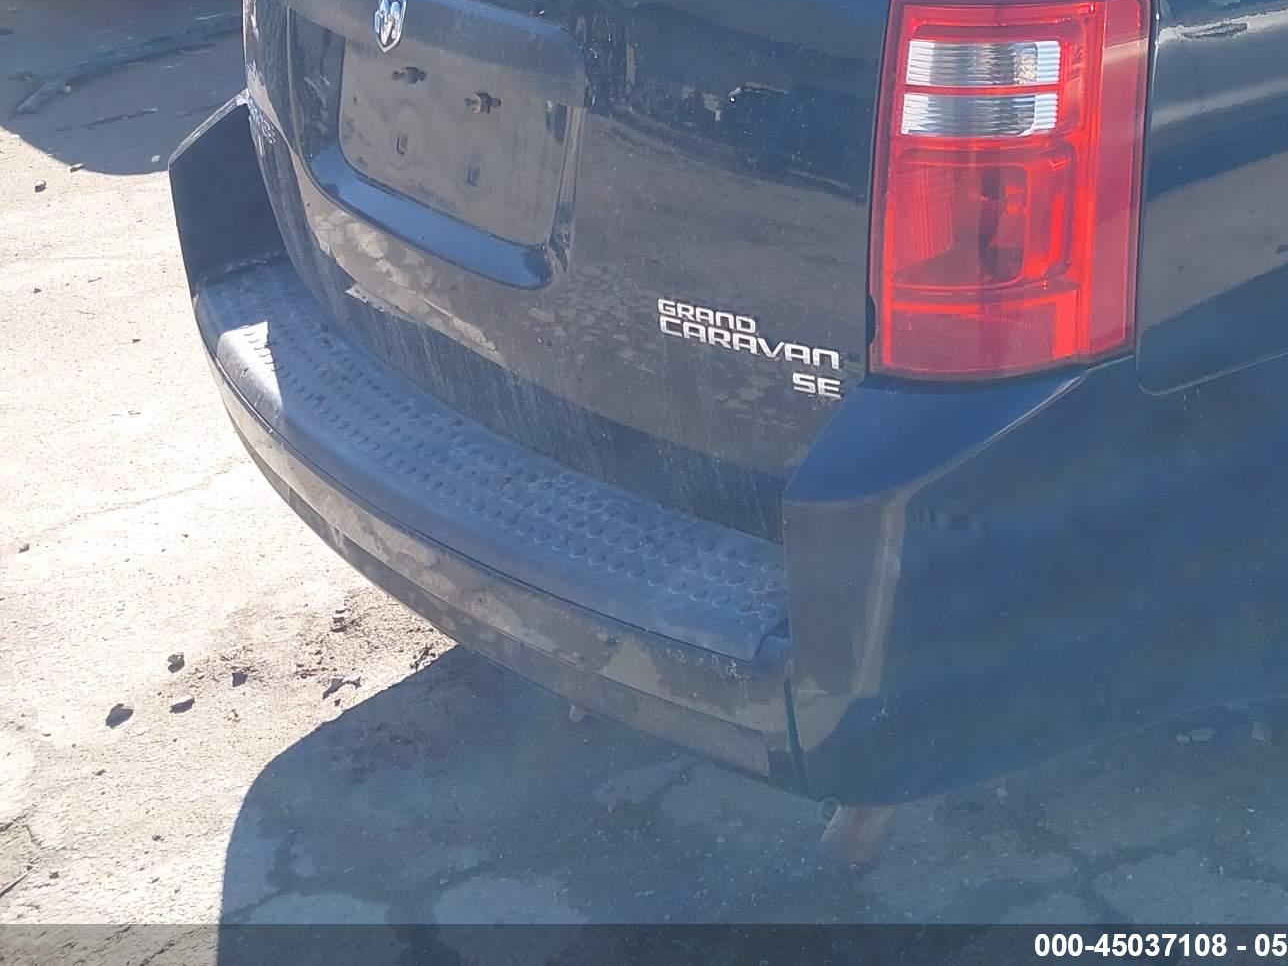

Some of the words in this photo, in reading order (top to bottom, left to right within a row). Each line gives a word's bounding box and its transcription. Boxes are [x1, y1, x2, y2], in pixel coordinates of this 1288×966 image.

[657, 298, 757, 335] GRAND
[659, 316, 841, 371] CARAVAN
[792, 372, 842, 399] SE
